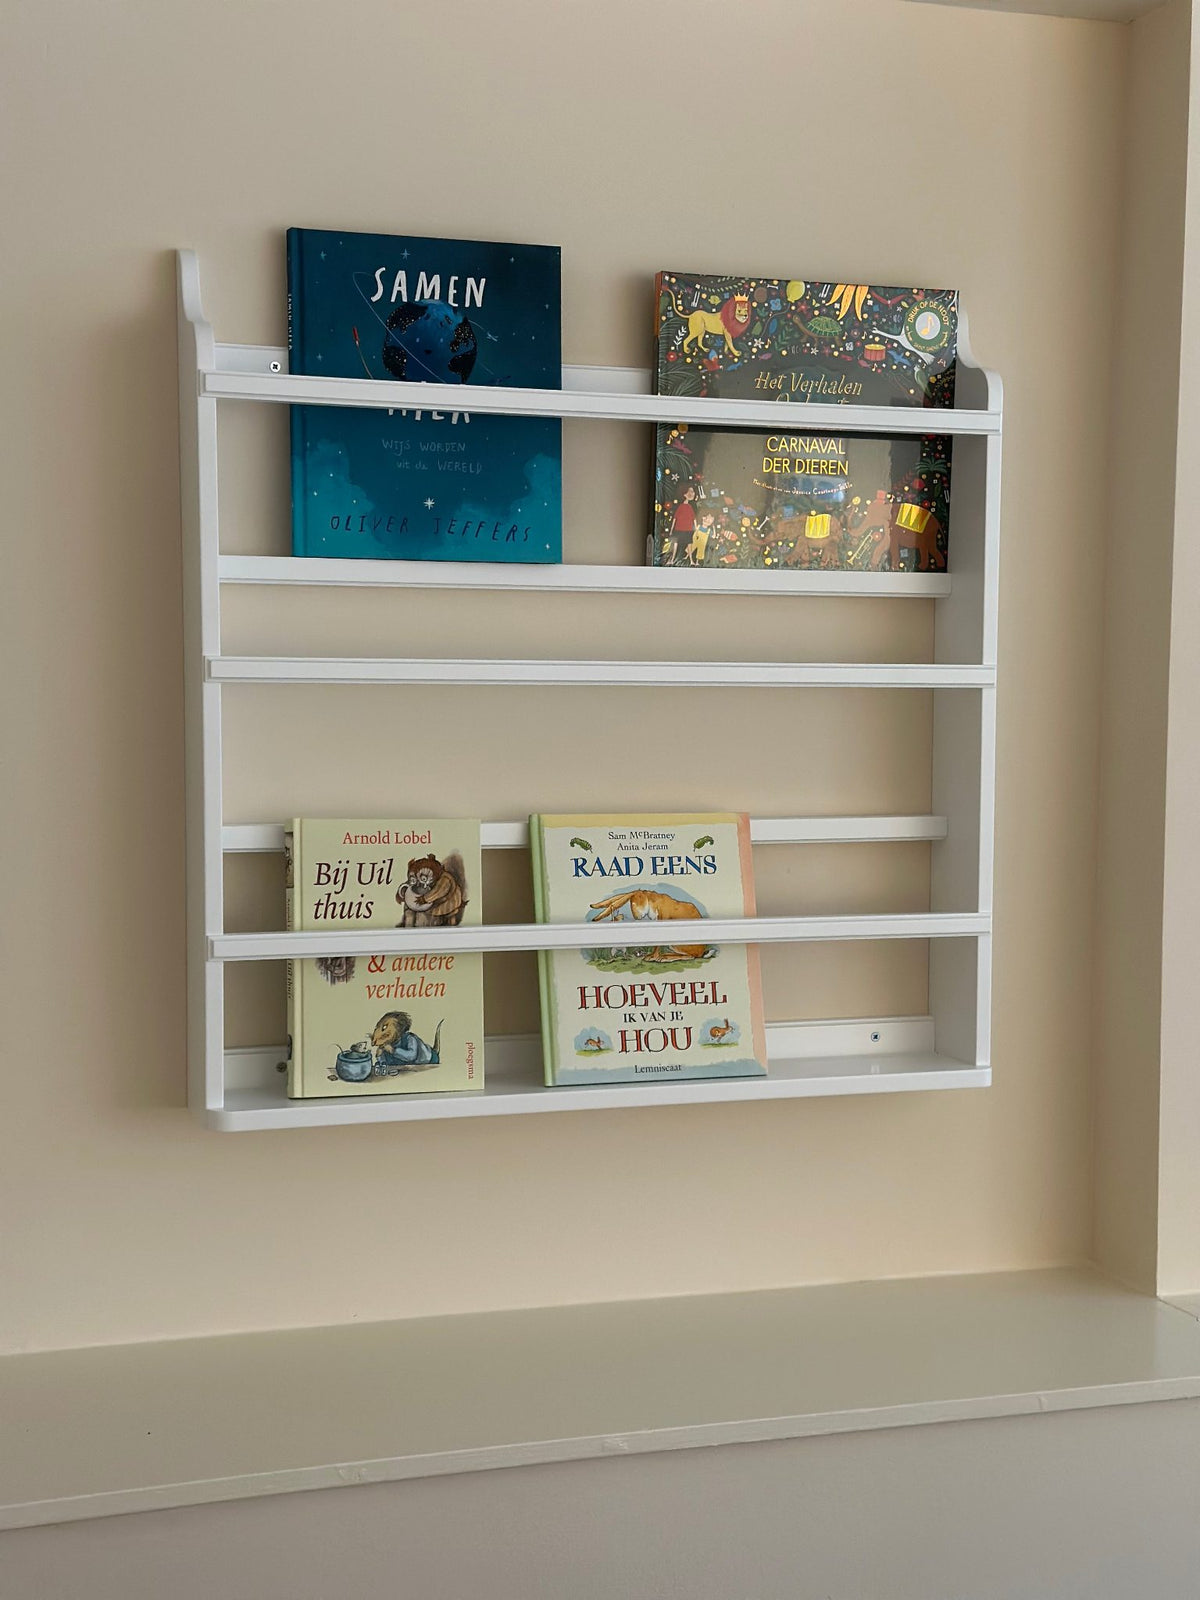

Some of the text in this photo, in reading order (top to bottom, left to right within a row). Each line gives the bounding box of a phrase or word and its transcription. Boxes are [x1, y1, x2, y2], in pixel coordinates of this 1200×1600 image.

[370, 266, 486, 308] SAMEN
[754, 371, 863, 396] Het Verhalen
[419, 441, 466, 453] WORDEN
[766, 436, 847, 455] CARNAVAL
[437, 460, 483, 474] WERELD
[762, 457, 849, 476] DER DIEREN
[330, 515, 532, 542] OLIVER JEFFERS
[342, 831, 432, 845] Arnold Lobel
[608, 831, 676, 842] Sam McBratney
[617, 843, 668, 851] Anita Jeram
[313, 858, 394, 894] Bij Uil
[570, 855, 717, 877] RAAD EENS
[313, 893, 374, 920] thuis
[367, 953, 455, 973] & andere
[365, 976, 446, 1000] verhalen
[577, 981, 728, 1010] HOEVEEL
[623, 1011, 683, 1023] IK VAN JE
[617, 1026, 693, 1054] HOU
[465, 1042, 475, 1080] ploegsma
[634, 1063, 682, 1074] Lemniscaat
